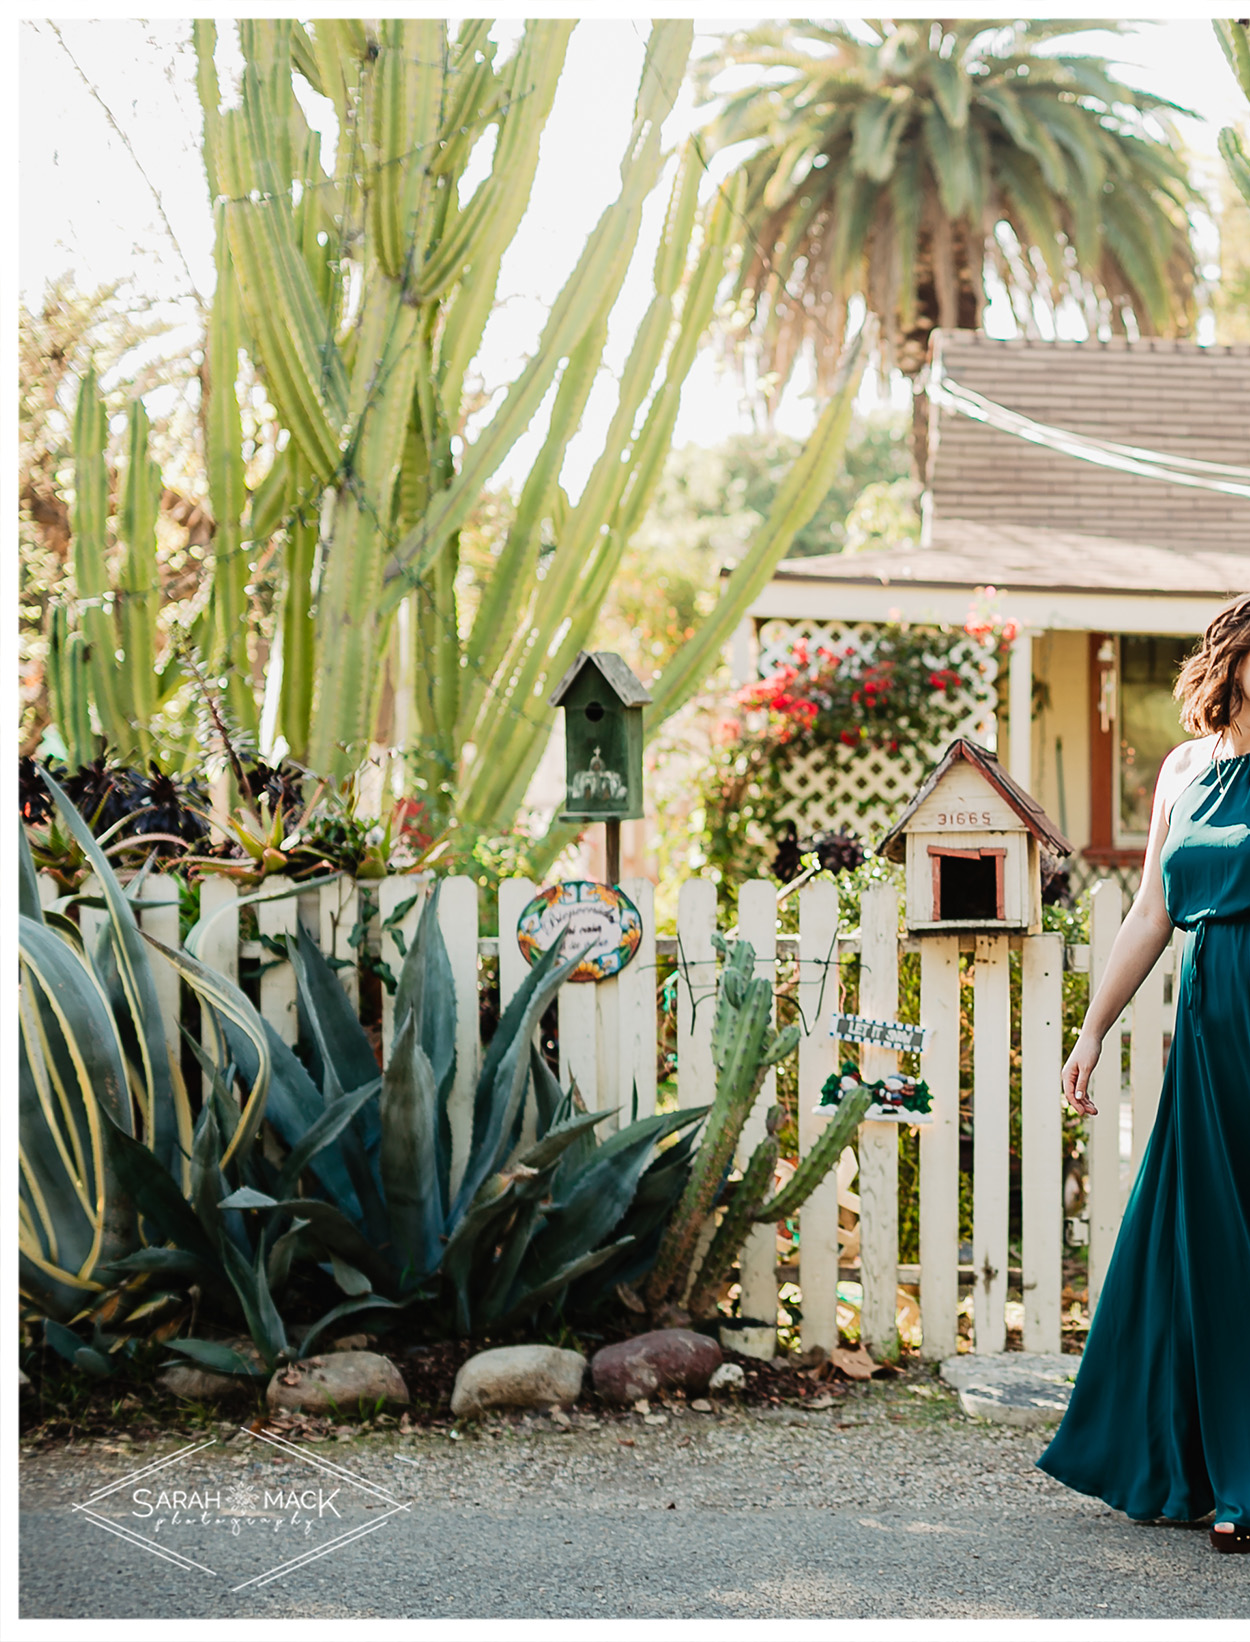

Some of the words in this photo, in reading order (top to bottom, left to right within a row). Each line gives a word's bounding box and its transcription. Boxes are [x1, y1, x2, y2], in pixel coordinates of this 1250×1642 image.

[938, 812, 991, 825] 31665
[848, 1021, 870, 1037] LET
[871, 1025, 883, 1039] IT
